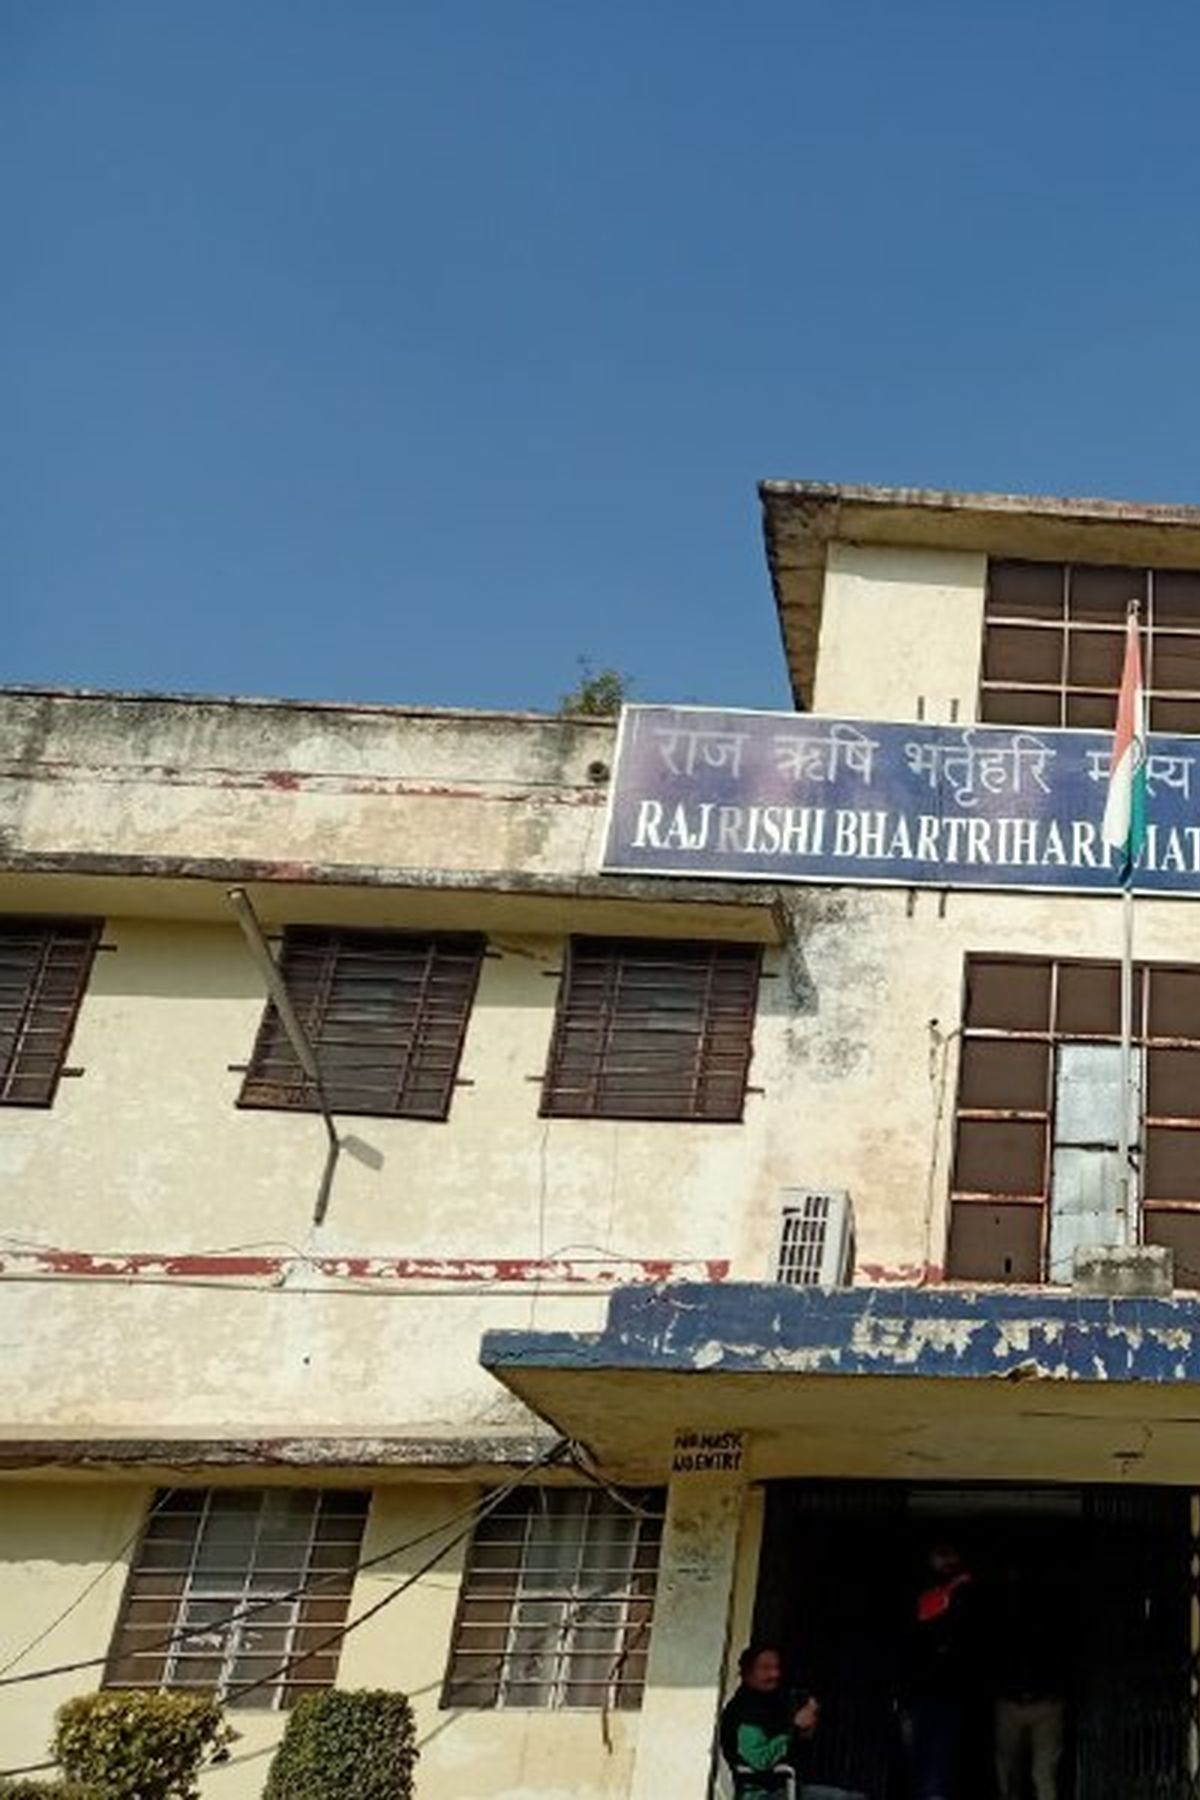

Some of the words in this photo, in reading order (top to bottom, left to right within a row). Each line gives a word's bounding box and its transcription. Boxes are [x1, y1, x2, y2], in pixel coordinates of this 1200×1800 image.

[653, 727, 751, 780] राज
[773, 723, 880, 786] ऋषि
[904, 727, 1057, 808] भर्तृहरि
[631, 799, 716, 851] RAJ
[714, 804, 827, 858] RISHI
